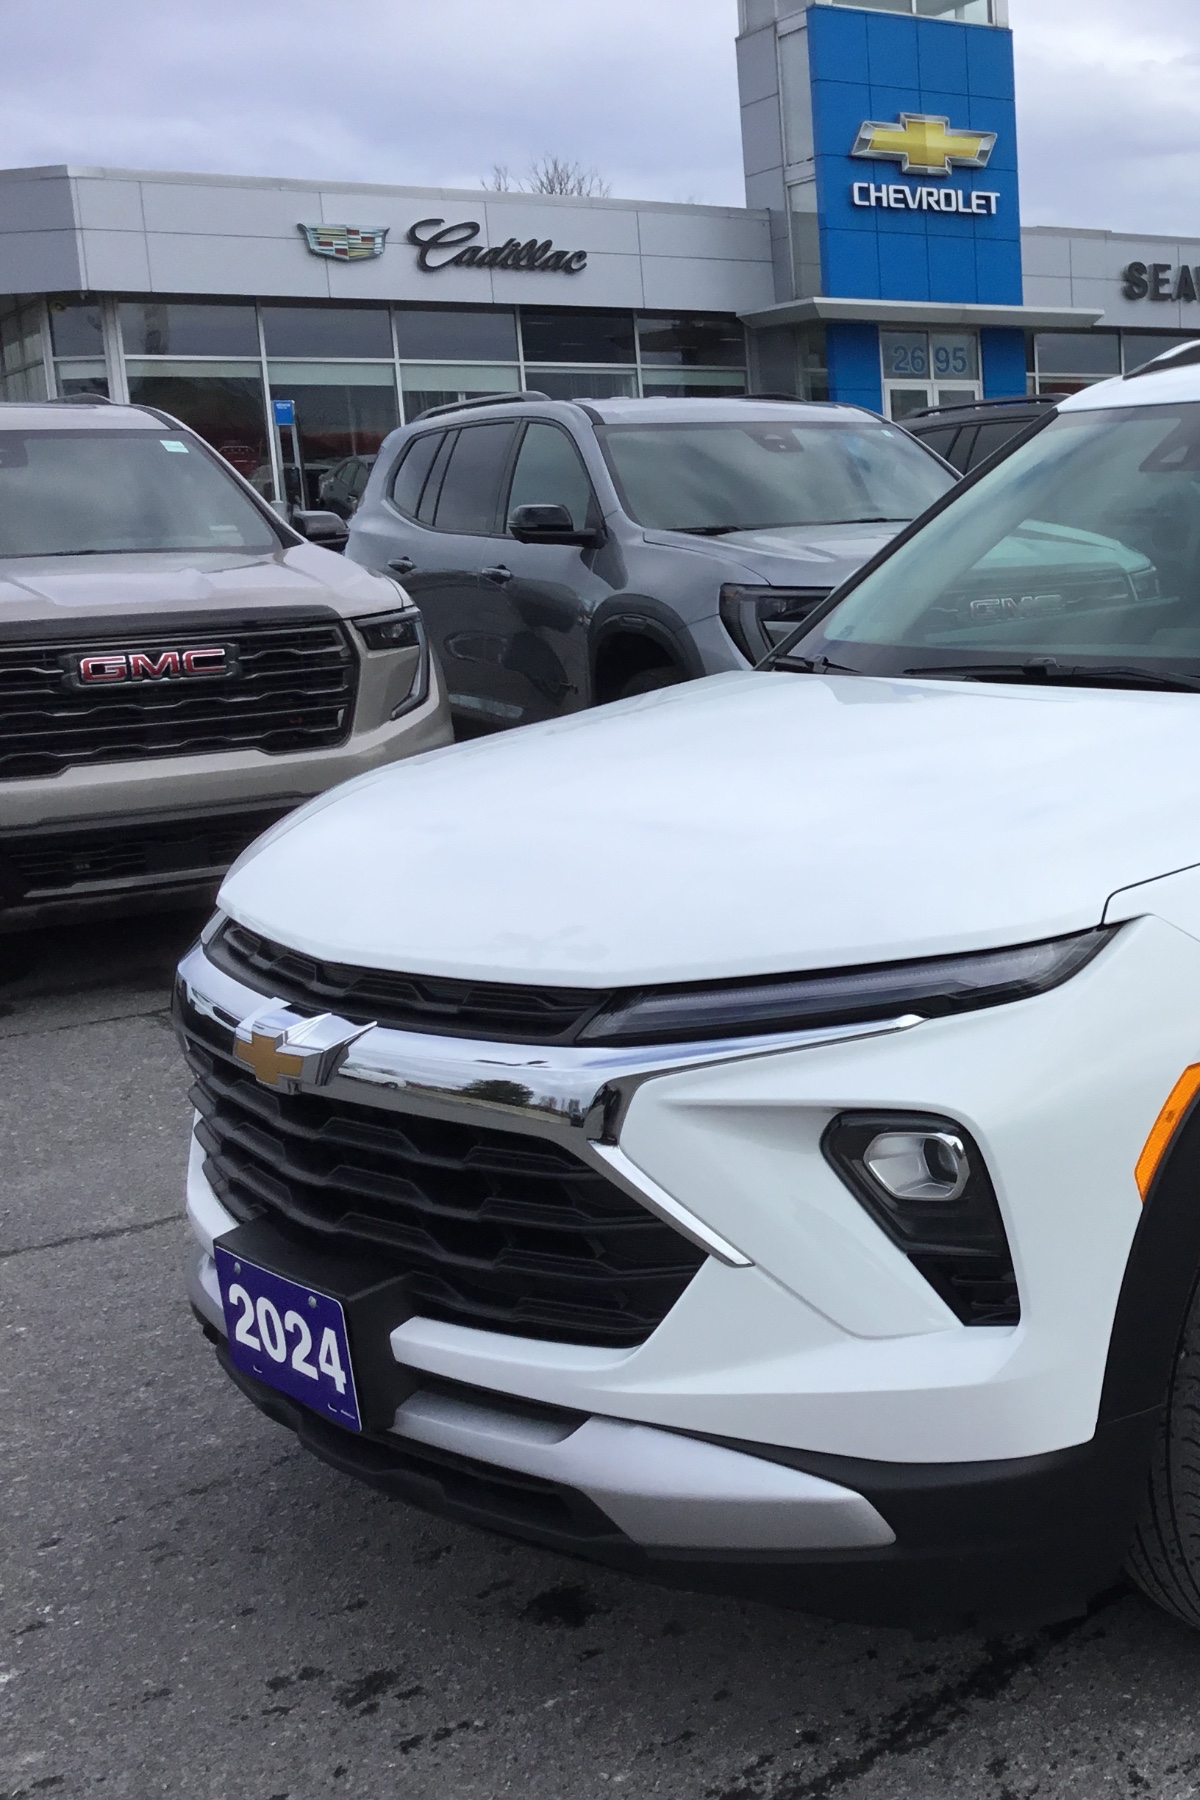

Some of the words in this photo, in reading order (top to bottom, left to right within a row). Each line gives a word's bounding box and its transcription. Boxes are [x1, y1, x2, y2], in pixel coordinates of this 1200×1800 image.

[853, 182, 1000, 214] CHEVROLET
[407, 218, 587, 274] Cadillac
[80, 649, 226, 682] GMC
[229, 1283, 346, 1395] 2024
